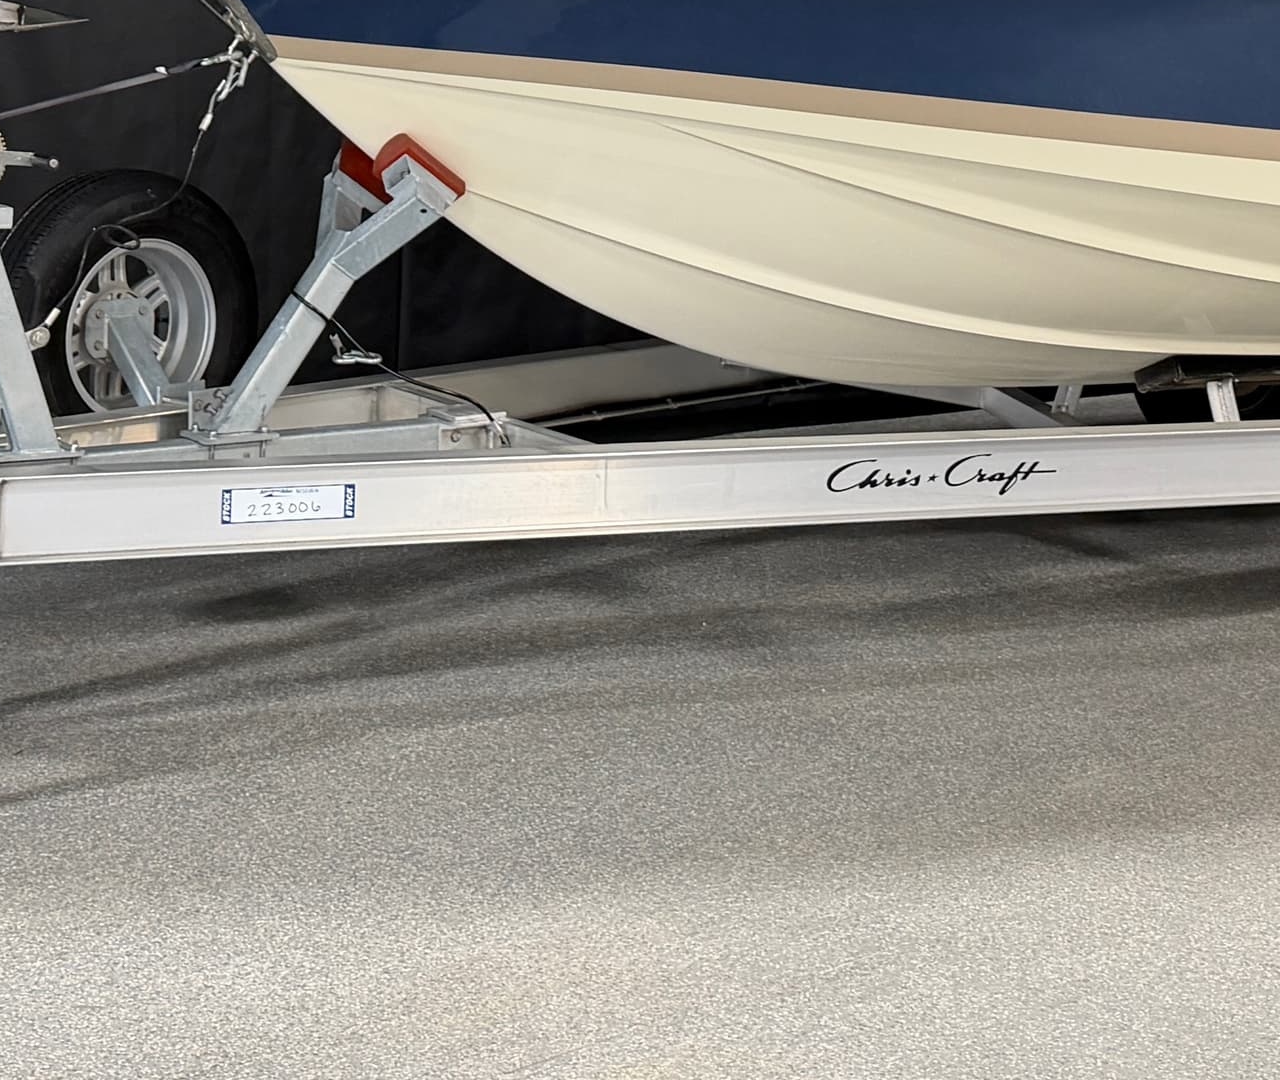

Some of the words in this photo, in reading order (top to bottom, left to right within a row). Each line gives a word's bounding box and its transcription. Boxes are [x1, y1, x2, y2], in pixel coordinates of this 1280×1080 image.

[826, 458, 922, 493] Chris
[943, 453, 1057, 496] Craft
[222, 491, 231, 522] STOCK
[247, 500, 321, 517] 223006
[345, 486, 354, 517] STOCK
